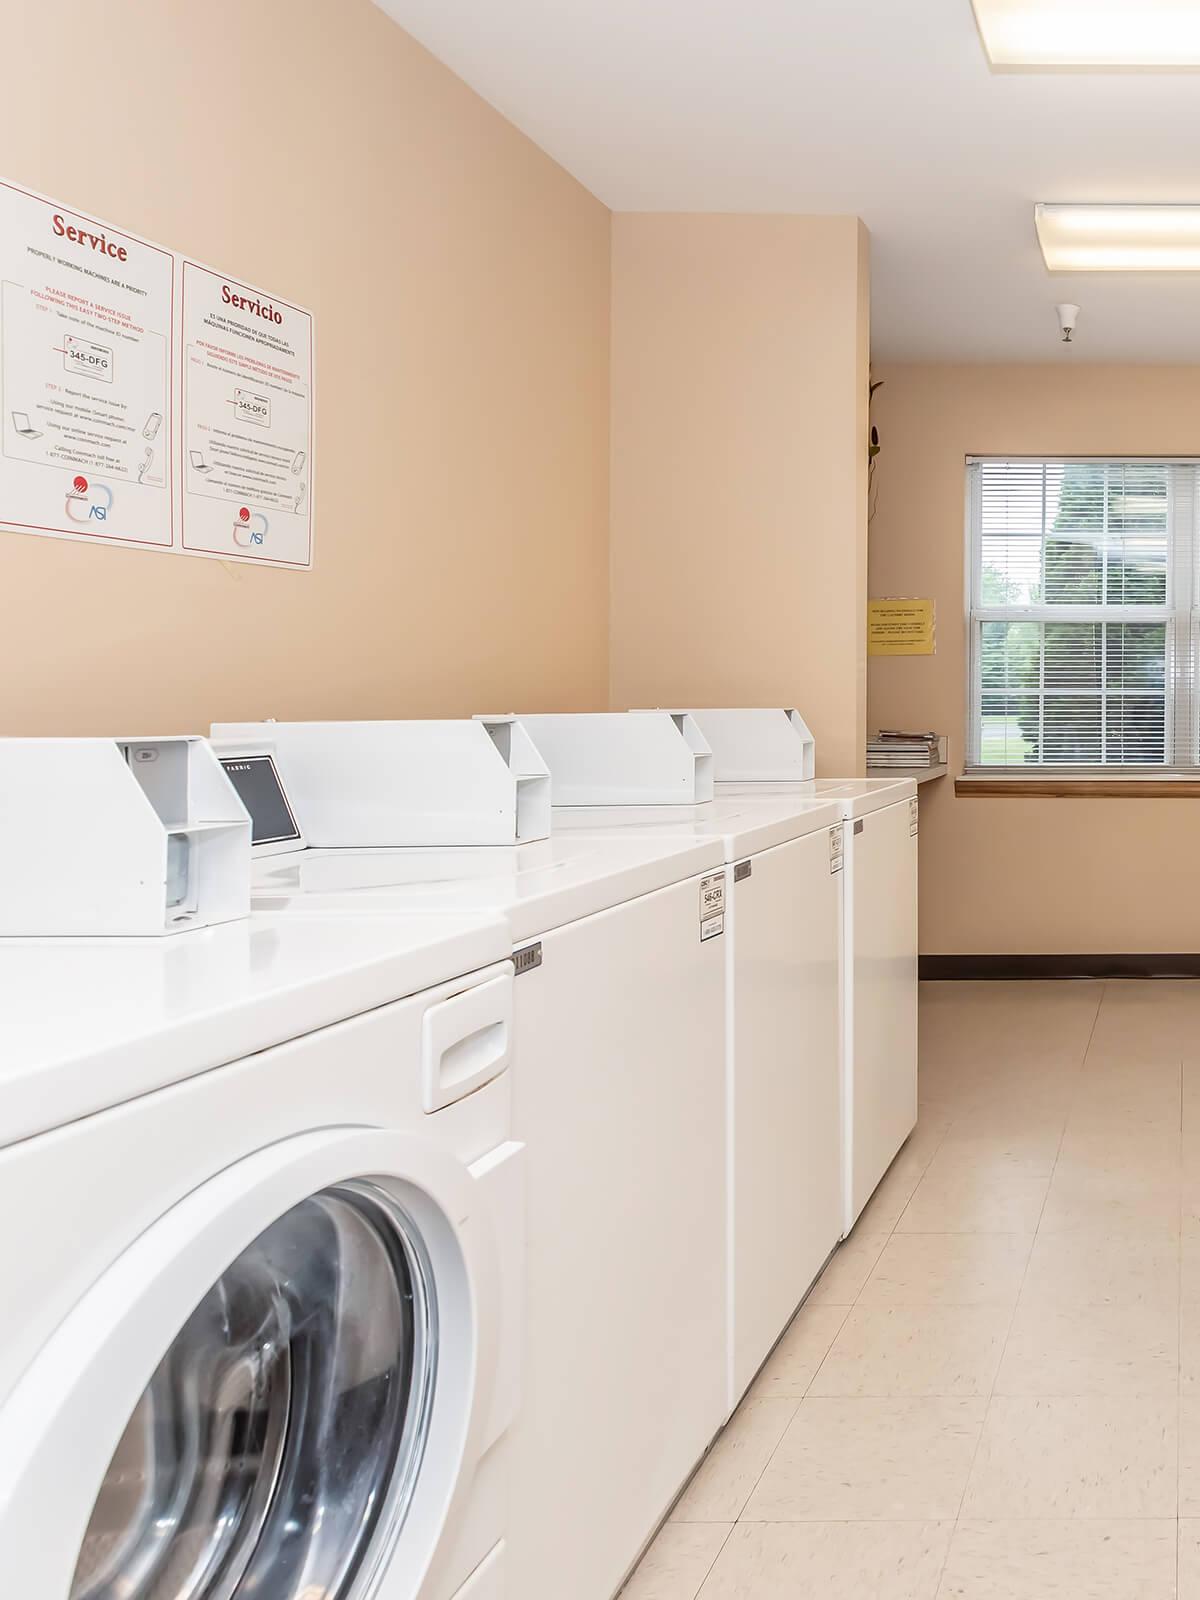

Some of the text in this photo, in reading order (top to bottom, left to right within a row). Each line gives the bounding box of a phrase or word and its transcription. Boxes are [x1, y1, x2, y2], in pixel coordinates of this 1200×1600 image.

[52, 214, 128, 262] Service
[28, 247, 56, 263] PROPERLY
[58, 258, 83, 272] WORKING
[84, 268, 110, 283] MACHINES
[112, 279, 120, 287] ARE
[126, 284, 147, 297] PRIORITY
[31, 290, 65, 306] FOLLOWING
[66, 302, 78, 311] THIS
[80, 307, 93, 316] EASY
[122, 322, 144, 334] METHOD
[46, 286, 66, 298] PLEASE
[68, 294, 88, 306] REPORT
[95, 304, 116, 316] SERVICE
[117, 312, 131, 321] ISSUE
[222, 285, 283, 324] Servicio
[70, 350, 108, 368] 345-DFG
[239, 401, 267, 415] 345-DFG
